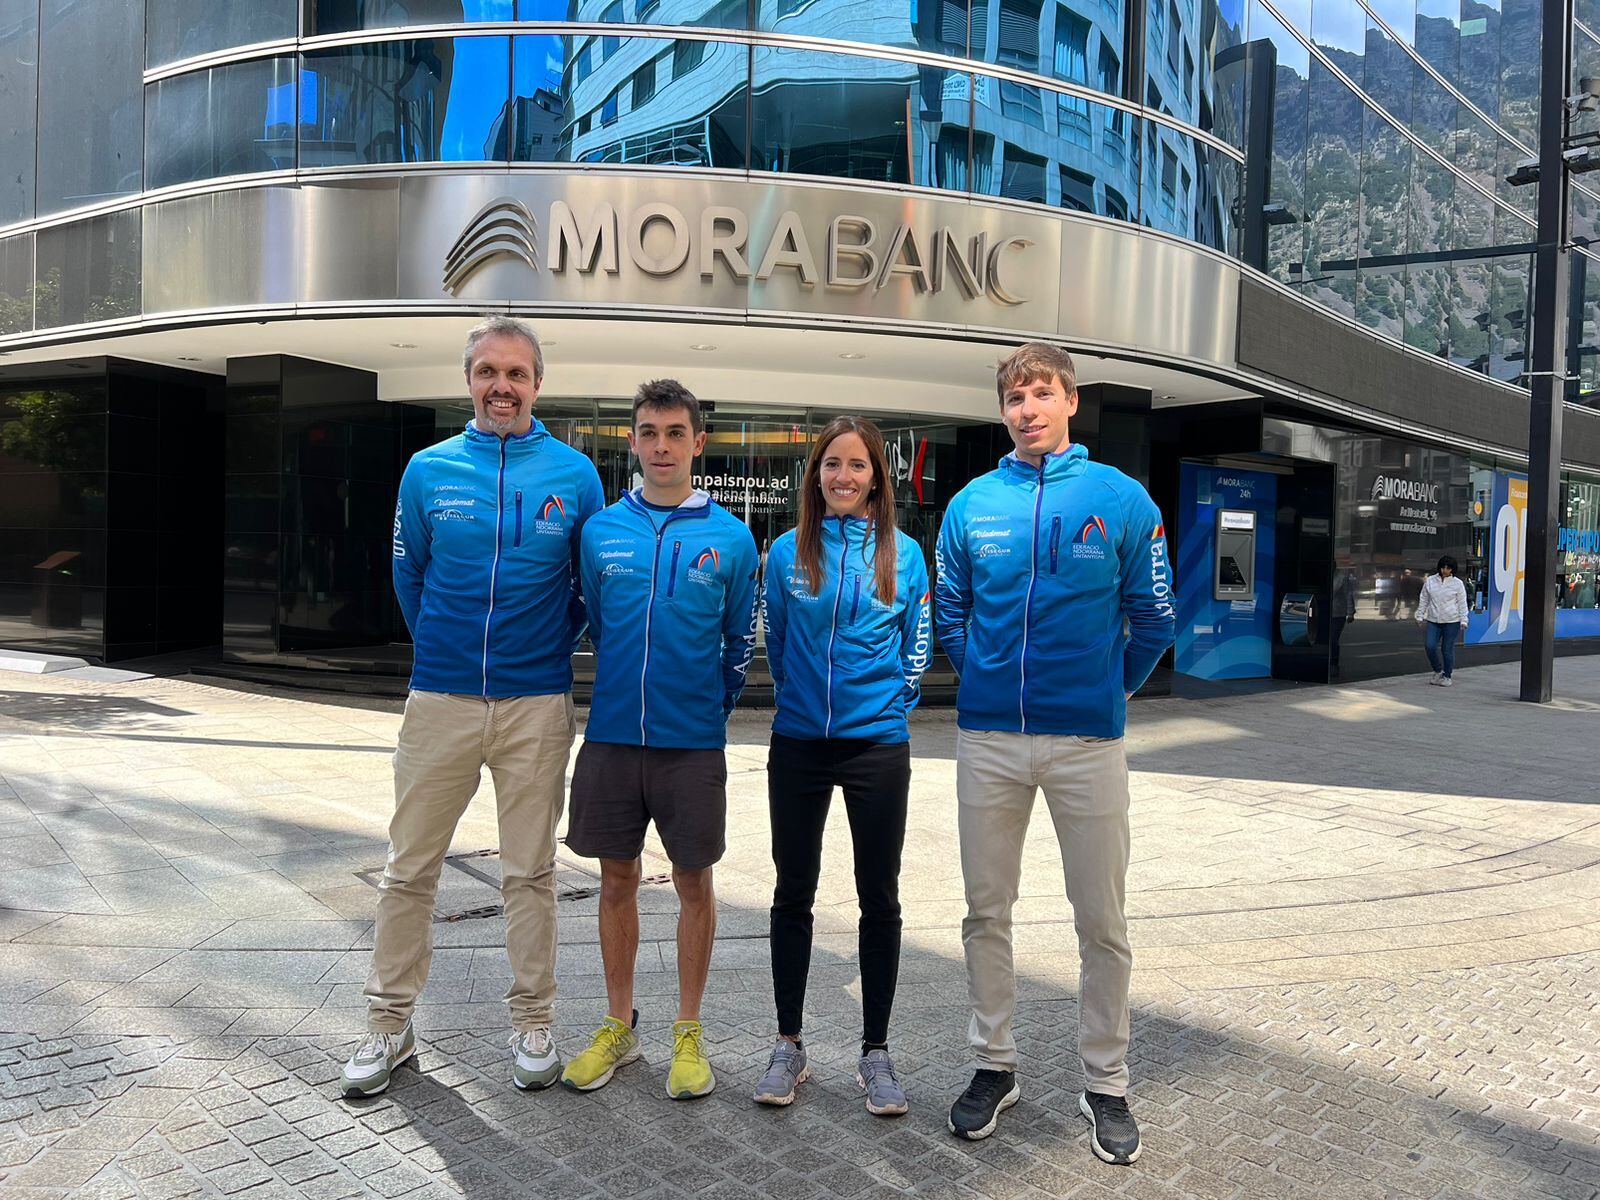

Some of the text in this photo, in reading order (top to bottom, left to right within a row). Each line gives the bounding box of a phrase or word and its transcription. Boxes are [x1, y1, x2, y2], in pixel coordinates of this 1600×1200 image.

[547, 200, 1036, 305] MORABANC
[690, 473, 789, 489] npaisnou.ad
[1385, 477, 1439, 504] MORABANC
